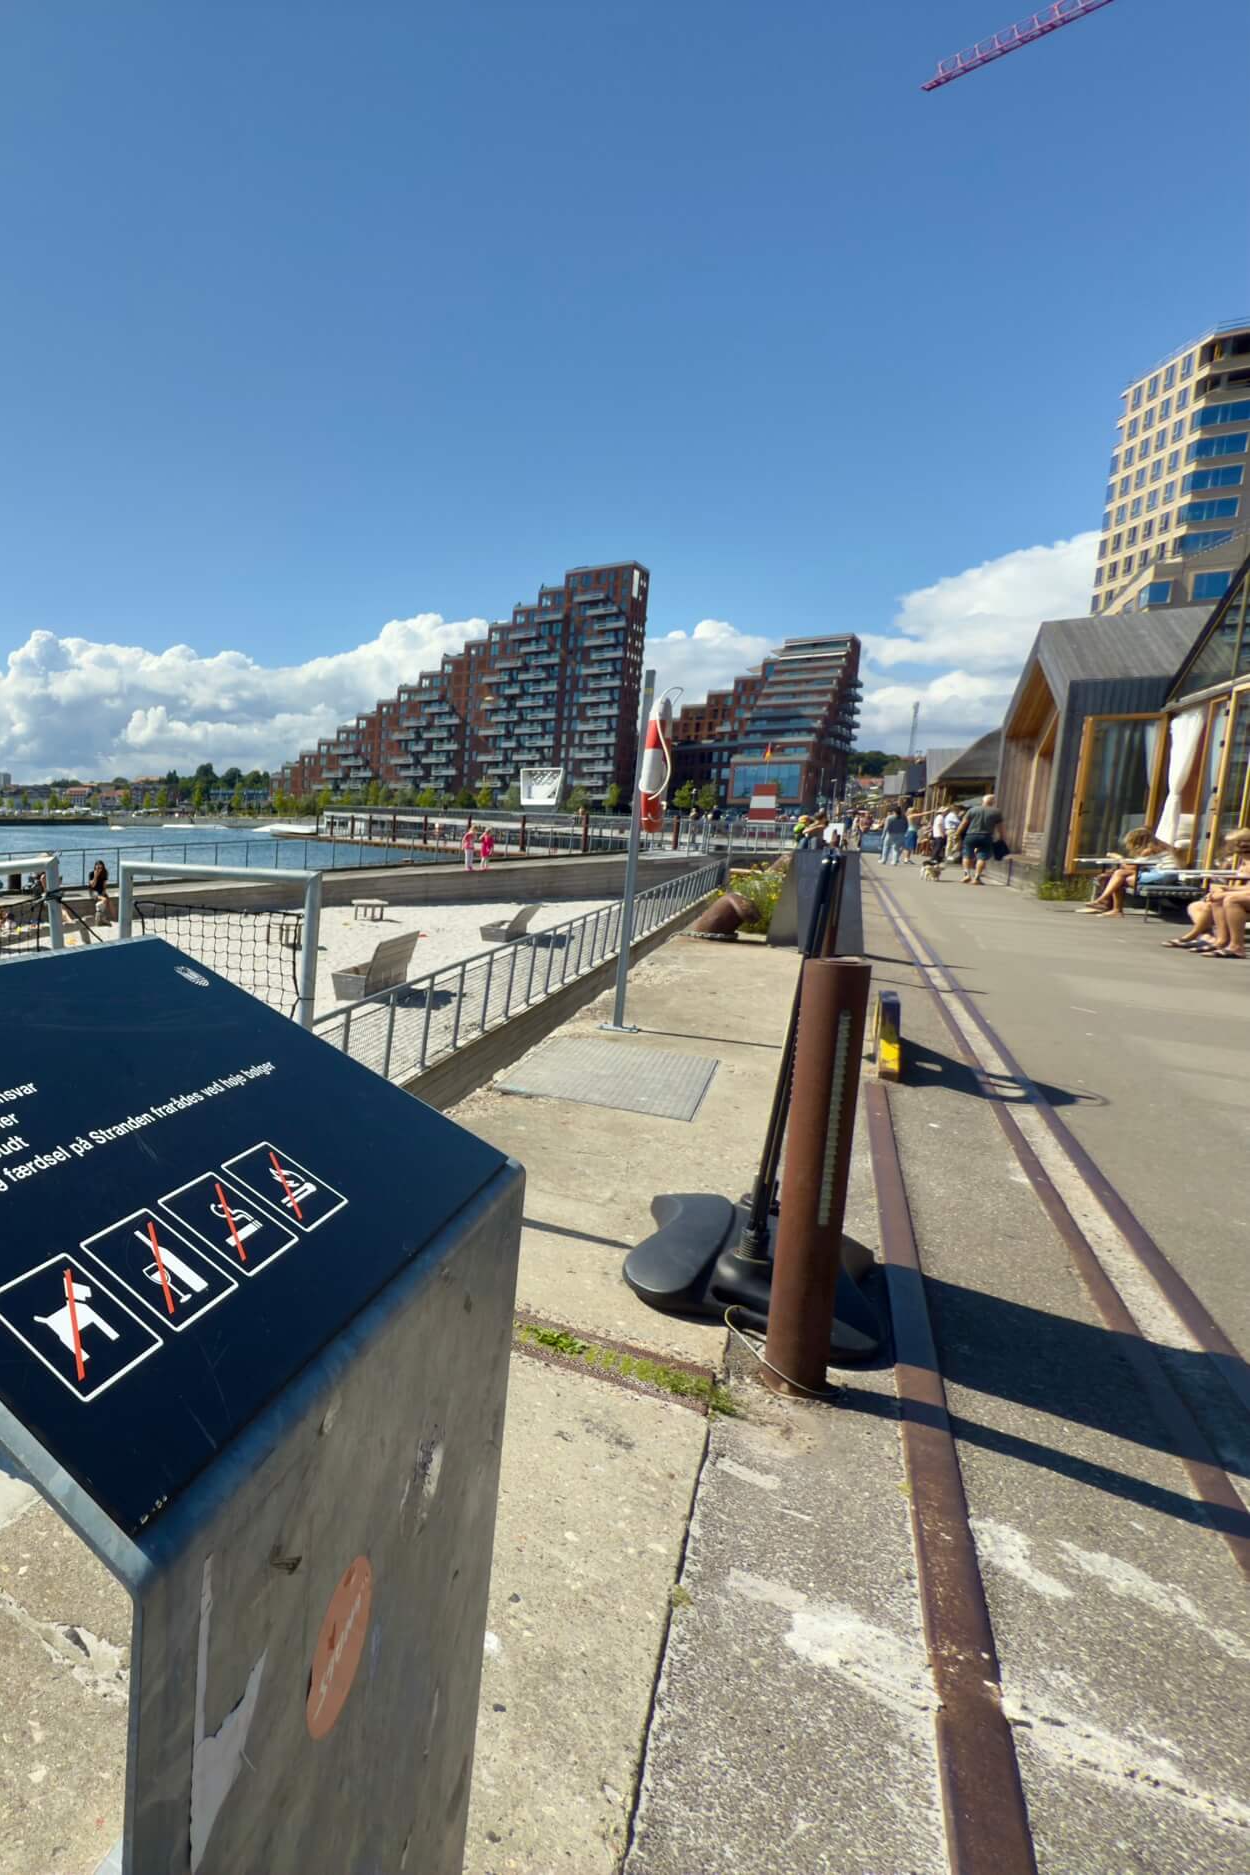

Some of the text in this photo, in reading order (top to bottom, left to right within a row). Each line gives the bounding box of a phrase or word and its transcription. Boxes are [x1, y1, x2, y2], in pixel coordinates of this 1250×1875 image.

[2, 1146, 72, 1182] færdsel
[68, 1136, 95, 1158] på
[88, 1112, 157, 1145] Stranden
[149, 1092, 205, 1119] frarådes
[200, 1080, 226, 1097] ved
[220, 1073, 248, 1088] høje
